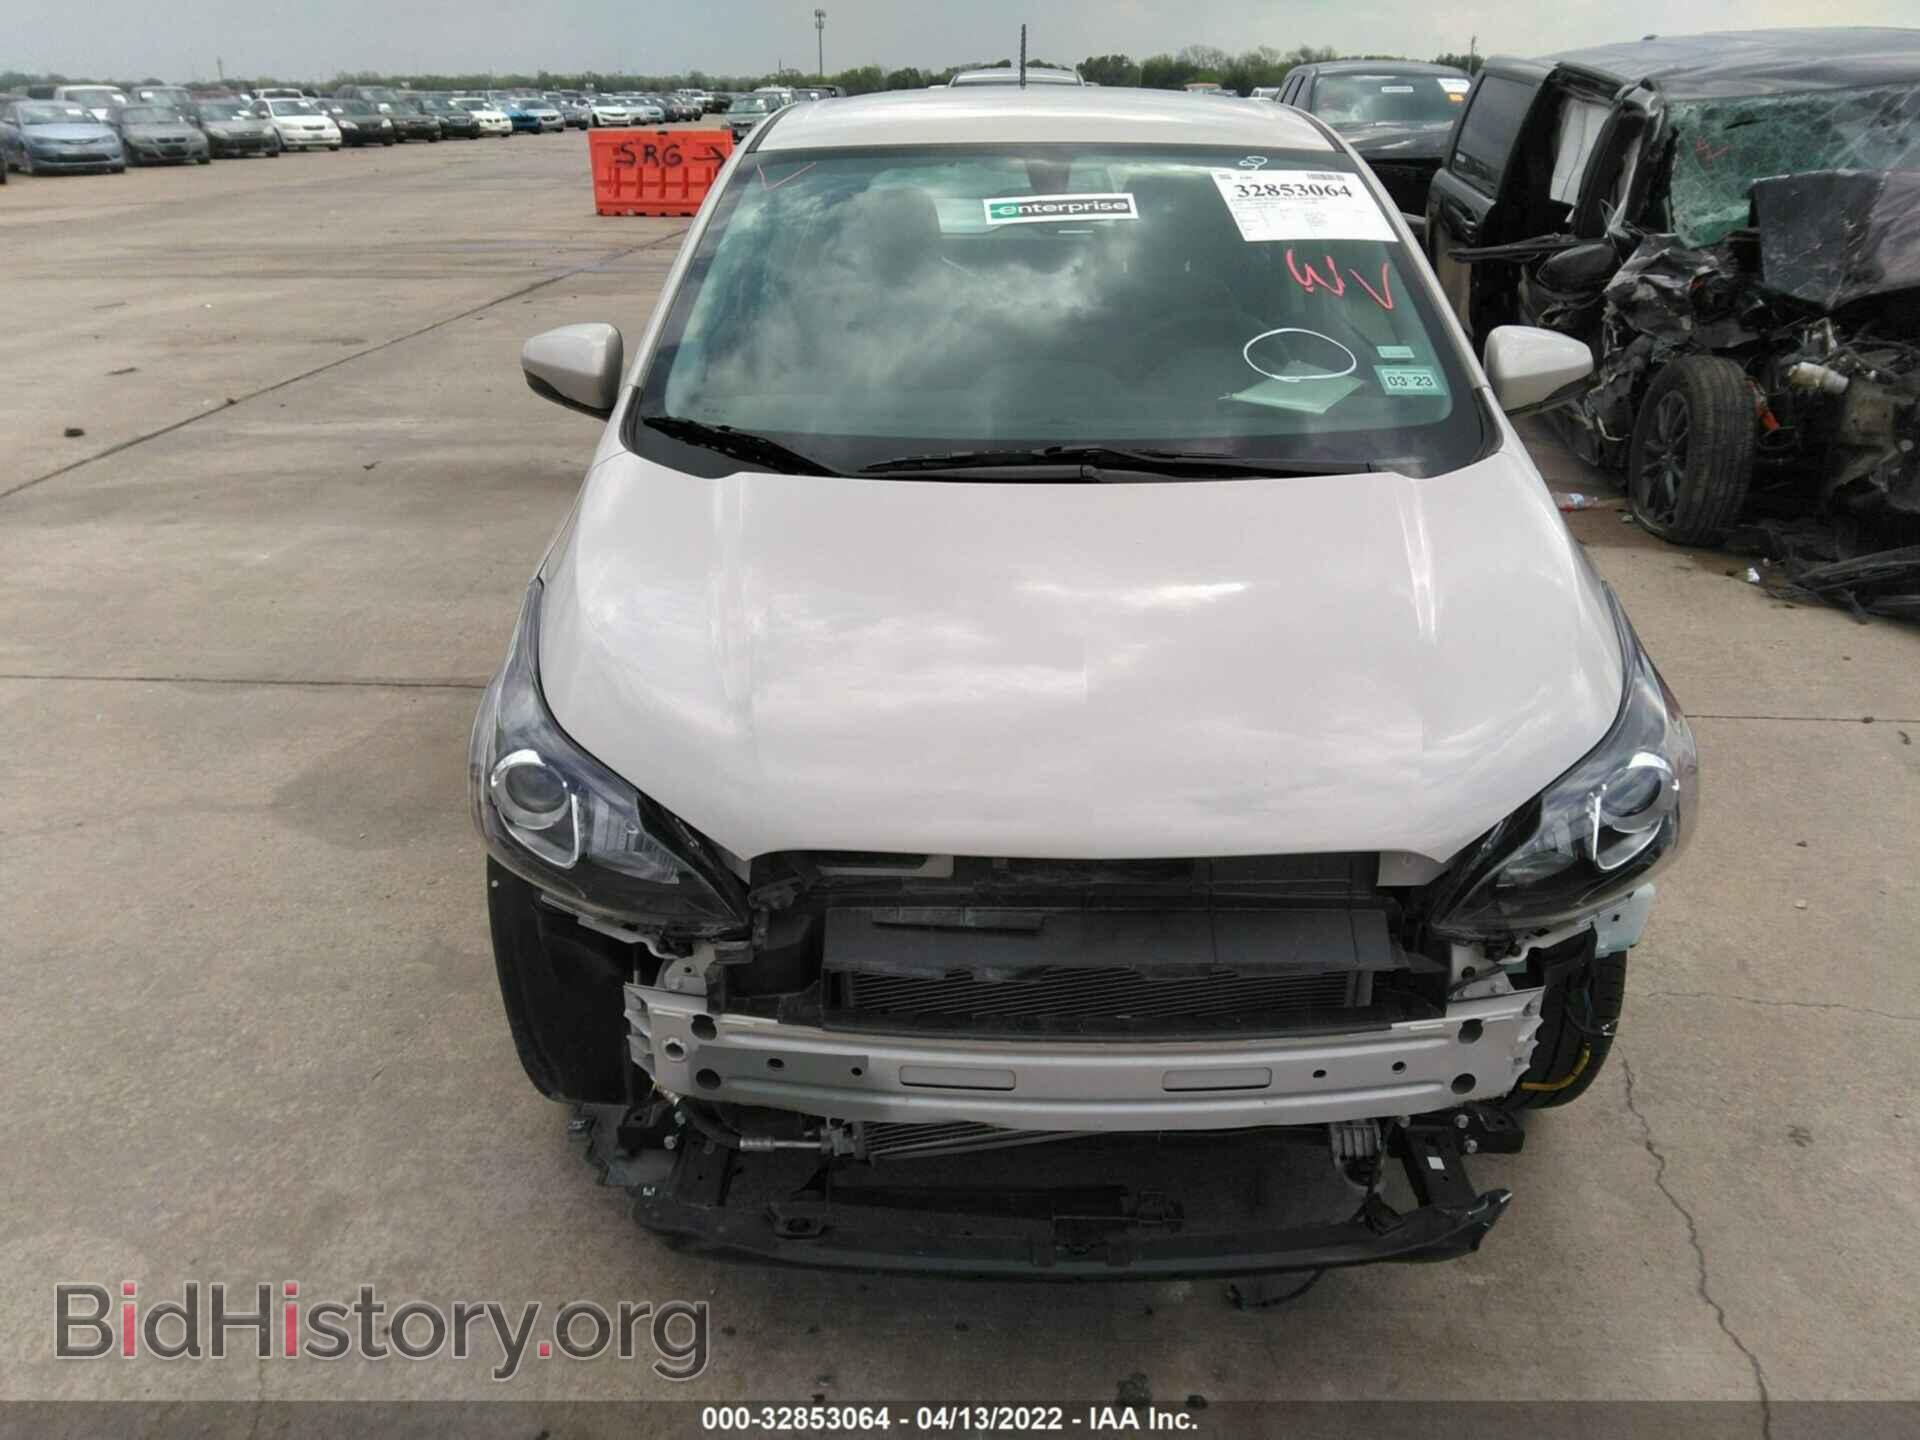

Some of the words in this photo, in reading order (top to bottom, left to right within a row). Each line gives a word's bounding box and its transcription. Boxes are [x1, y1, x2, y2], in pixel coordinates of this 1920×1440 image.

[615, 142, 683, 167] SRG
[1234, 183, 1353, 198] 32853064
[991, 199, 1129, 216] enterprise
